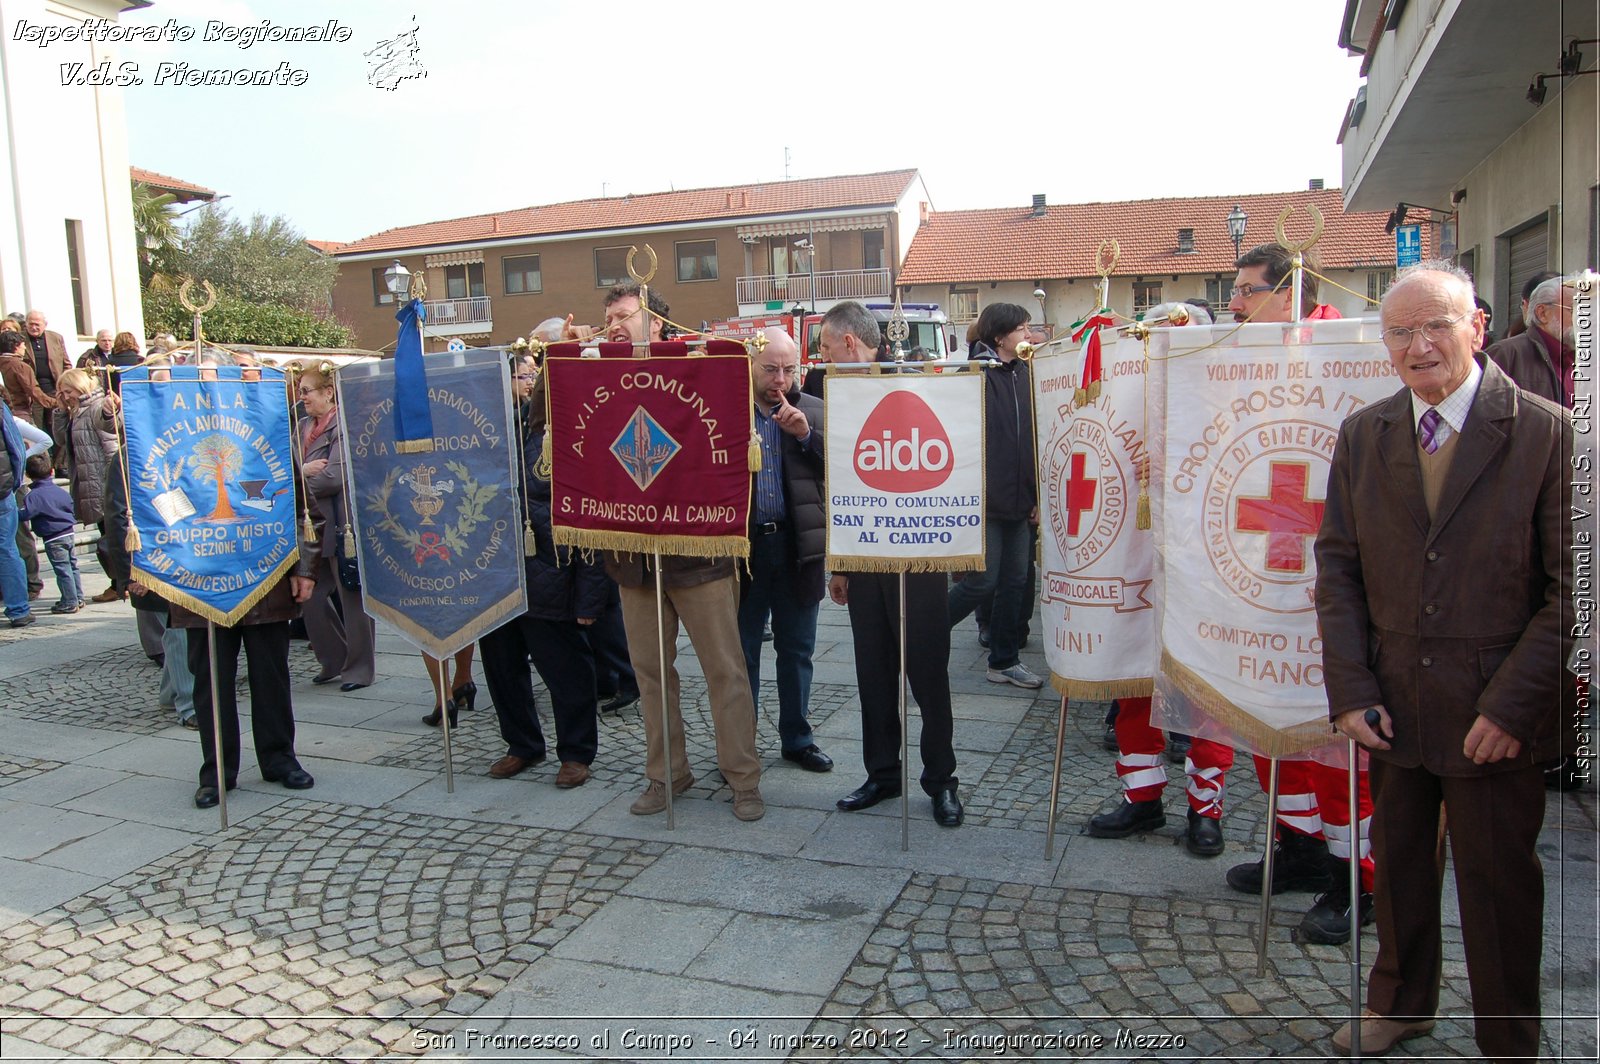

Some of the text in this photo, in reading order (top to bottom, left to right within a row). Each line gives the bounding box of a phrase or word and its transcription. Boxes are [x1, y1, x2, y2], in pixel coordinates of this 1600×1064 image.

[1206, 363, 1279, 381] VOLONTARI
[1287, 361, 1312, 379] DEL
[620, 372, 728, 465] COMUNALE
[184, 414, 254, 441] LAVORATORI
[251, 435, 289, 483] ANZIANI
[373, 441, 388, 456] LA
[857, 427, 949, 472] aido
[1172, 412, 1230, 494] CROCE
[1231, 384, 1326, 422] ROSSA
[561, 496, 736, 523] S. FRANCESCO AL CAMPO
[832, 495, 980, 508] GRUPPO COMUNALE
[1101, 475, 1121, 537] AGOSTO
[1208, 426, 1337, 598] CONVENZIONE DI GINEVR
[155, 521, 284, 545] GRUPPO MISTO
[833, 514, 980, 528] SAN FRANCESCO
[193, 539, 251, 557] SEZIONE DI
[858, 532, 953, 544] AL CAMPO
[1075, 536, 1103, 565] 1864
[147, 537, 289, 592] SAN FRANCESCO AL CAMPO
[366, 519, 508, 591] SAN FRANCESCO AL CAMPO
[438, 596, 457, 606] NEL
[1072, 584, 1119, 599] LOCALE
[1198, 621, 1288, 651] COMITATO
